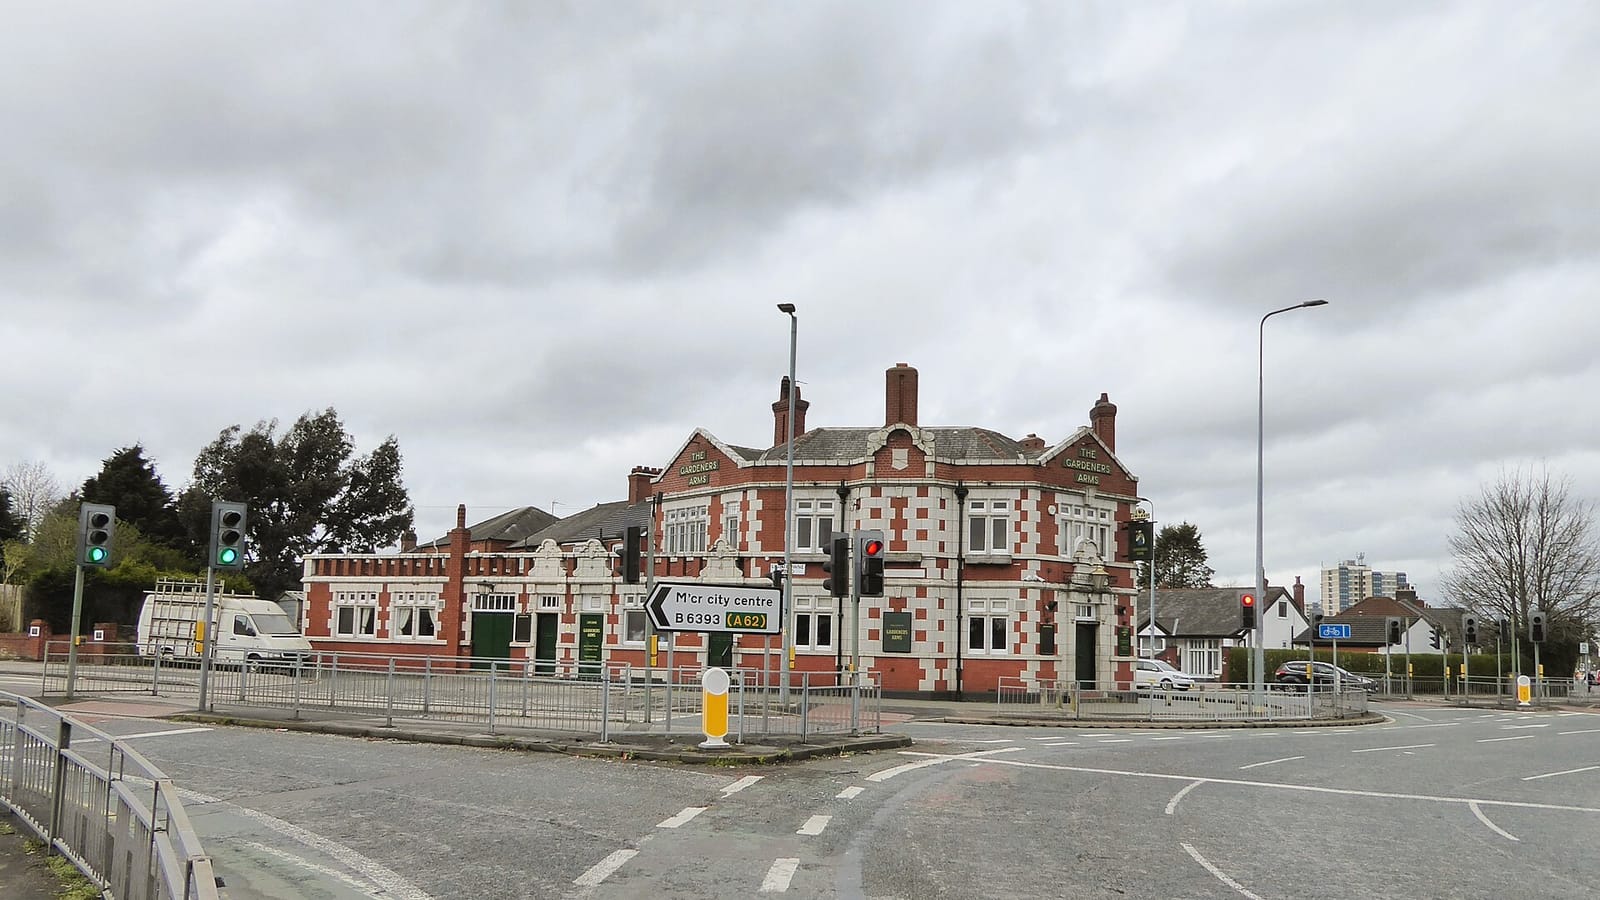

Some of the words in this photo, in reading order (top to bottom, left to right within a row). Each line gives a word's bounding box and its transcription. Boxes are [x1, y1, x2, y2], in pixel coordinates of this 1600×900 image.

[691, 451, 706, 461] THE
[1080, 448, 1096, 458] THE
[680, 461, 718, 475] GARDENERS
[1065, 458, 1111, 474] GARDENERS
[688, 475, 707, 485] ARMS
[1077, 474, 1099, 484] ARMS
[676, 592, 703, 604] M'cr
[707, 593, 730, 607] city
[734, 596, 773, 607] centre
